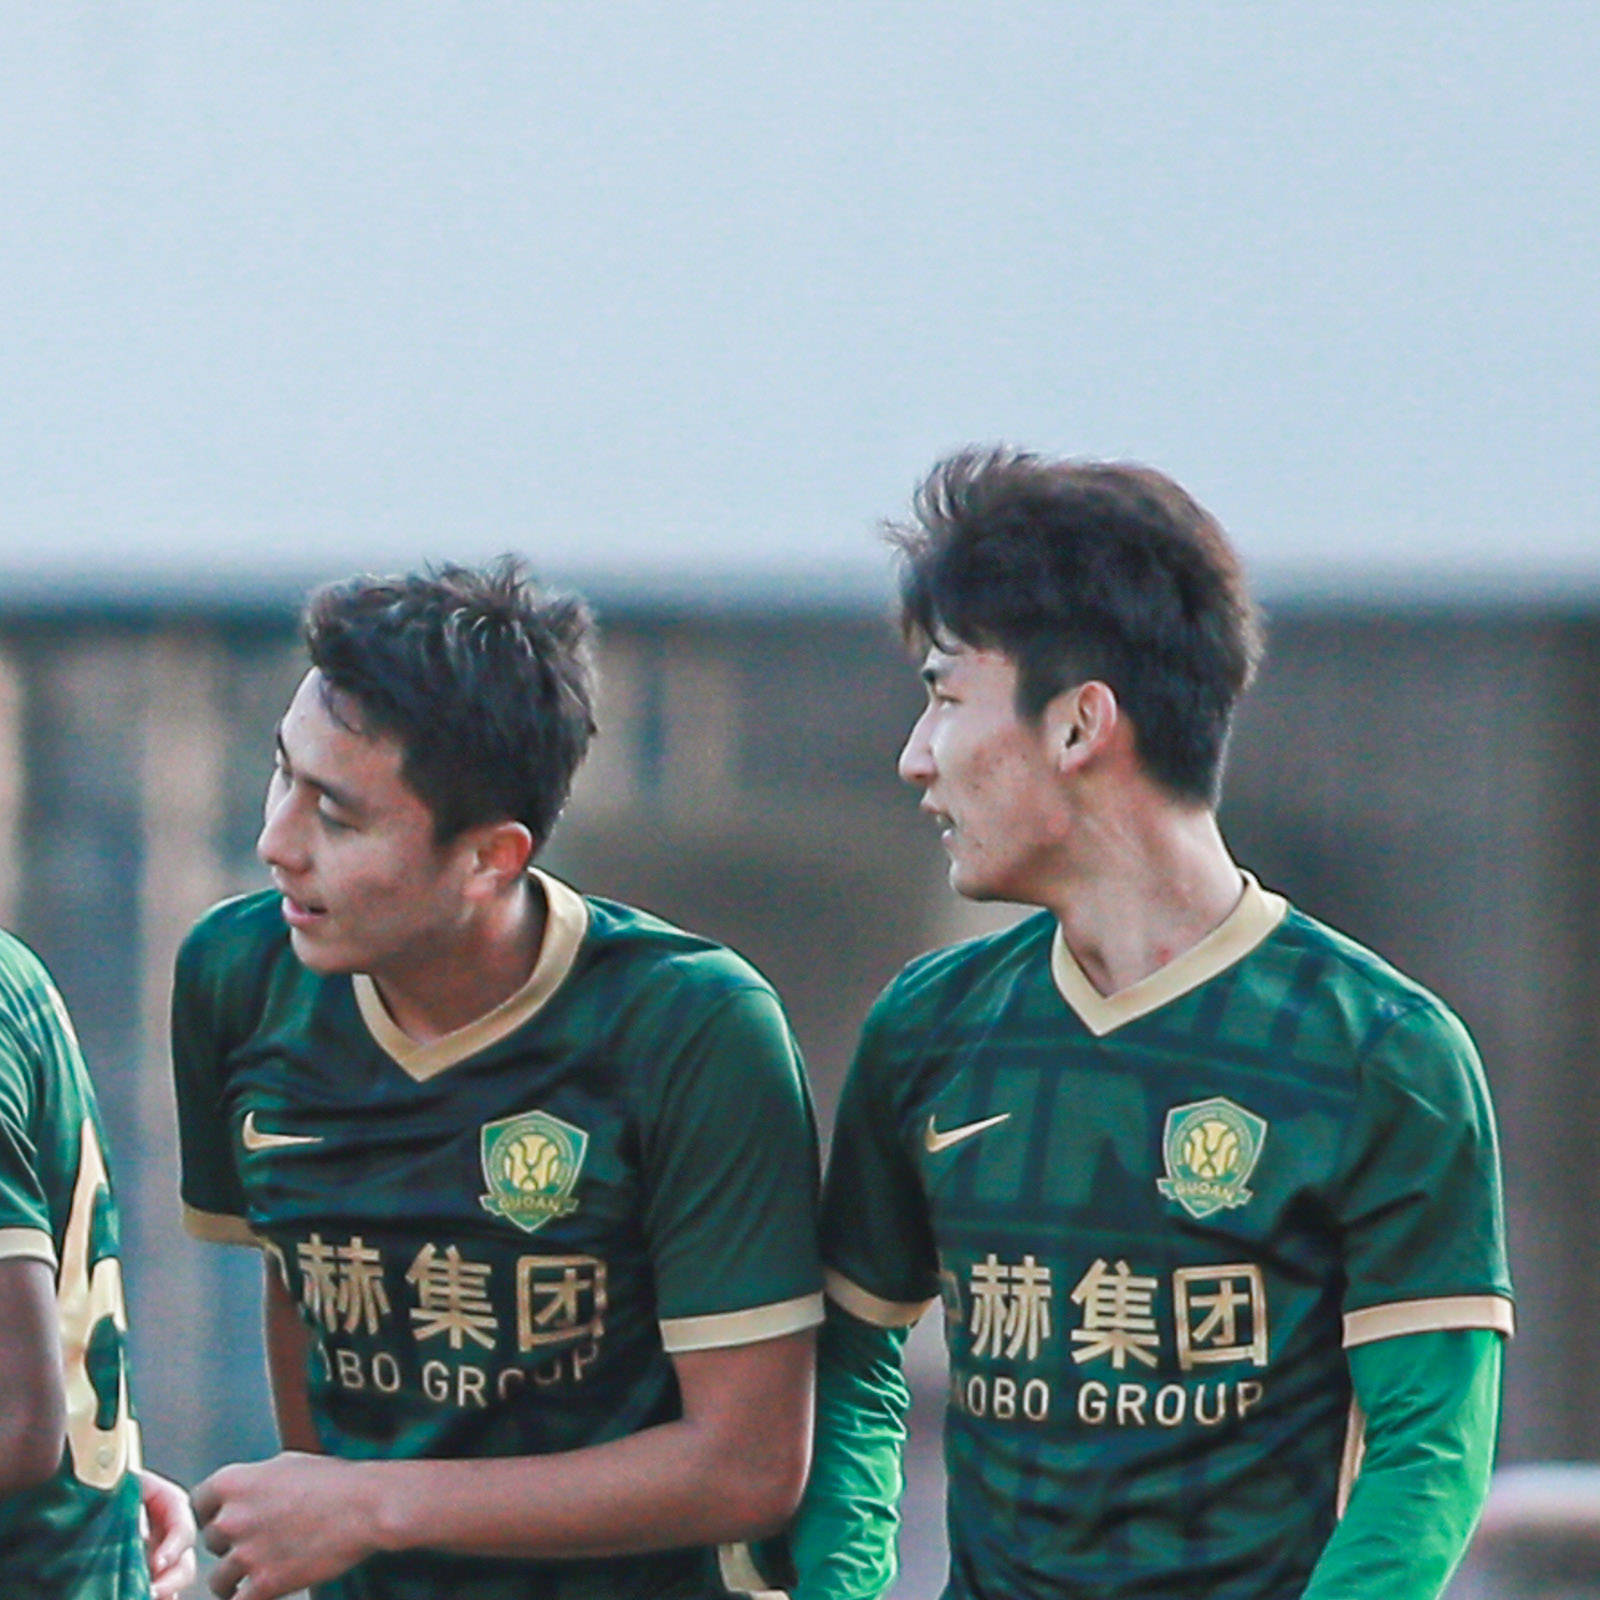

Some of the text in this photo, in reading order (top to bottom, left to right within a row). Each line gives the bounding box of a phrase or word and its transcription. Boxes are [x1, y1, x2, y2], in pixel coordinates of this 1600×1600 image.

[297, 1232, 608, 1353] 赫集团
[957, 1374, 1264, 1428] OBO GROUP
